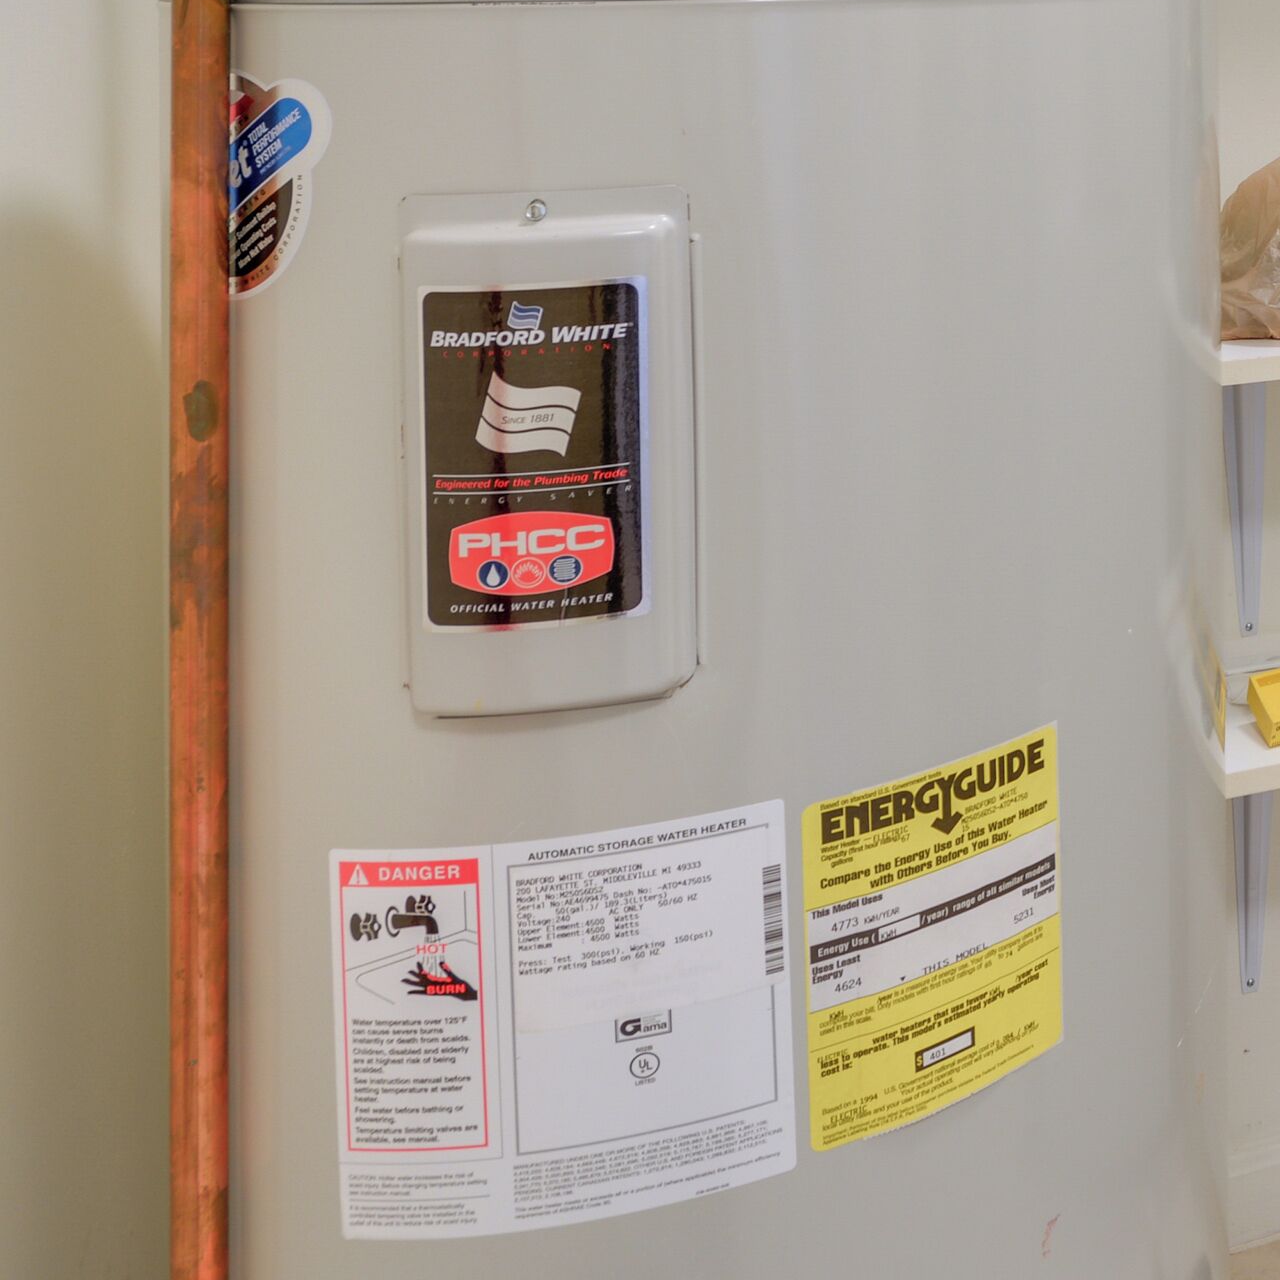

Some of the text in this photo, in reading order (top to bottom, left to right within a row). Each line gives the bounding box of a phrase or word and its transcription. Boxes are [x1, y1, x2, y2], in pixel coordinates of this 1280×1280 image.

[430, 322, 628, 348] BRADFORD WHITE
[500, 413, 555, 425] SINCE 1881
[435, 468, 628, 491] Engineered for the Plumbing Trade
[433, 484, 632, 505] ENERGY SAVER
[458, 524, 606, 558] PHCC
[450, 592, 614, 614] OFFICIAL WATER HEATER
[821, 738, 1045, 845] ENERGYGUIDE
[528, 818, 747, 862] AUTOMATIC STORAGE WATER HEATER
[820, 800, 1048, 890] Compare the Energy Use of this Water Heater
[870, 830, 1012, 889] with Others Before You Buy.
[378, 865, 461, 881] DANGER
[515, 863, 643, 887] BRADFORD WHITE CORPORATION
[516, 860, 702, 896] 200 LAFAYETTE MIDDLEVILLE MI 49333
[516, 894, 541, 904] Model
[613, 889, 635, 899] Dash
[1022, 884, 1039, 897] Uses
[623, 903, 644, 913] ONLY
[657, 896, 684, 908] 50/60
[687, 892, 698, 902] HZ
[811, 893, 884, 921] This Model Uses
[817, 861, 1051, 958] Energy Use range of all similar models
[831, 906, 901, 933] 4773 KWH/YEAR
[1013, 906, 1035, 925] 5231
[517, 927, 542, 937] Upper
[518, 935, 542, 944] Lower
[590, 933, 611, 943] 4500
[415, 943, 448, 956] HOT
[552, 955, 572, 964] Test
[630, 940, 666, 953] Working
[923, 942, 989, 976] THIS MODEL
[557, 960, 588, 972] rating
[591, 956, 617, 967] based
[620, 954, 632, 962] on
[812, 954, 861, 976] Uses Least
[812, 968, 844, 985] Energy
[834, 977, 862, 993] 4624
[426, 983, 466, 995] BURN
[929, 1047, 947, 1060] 401
[638, 1058, 654, 1071] UL
[860, 1093, 878, 1105] 1994
